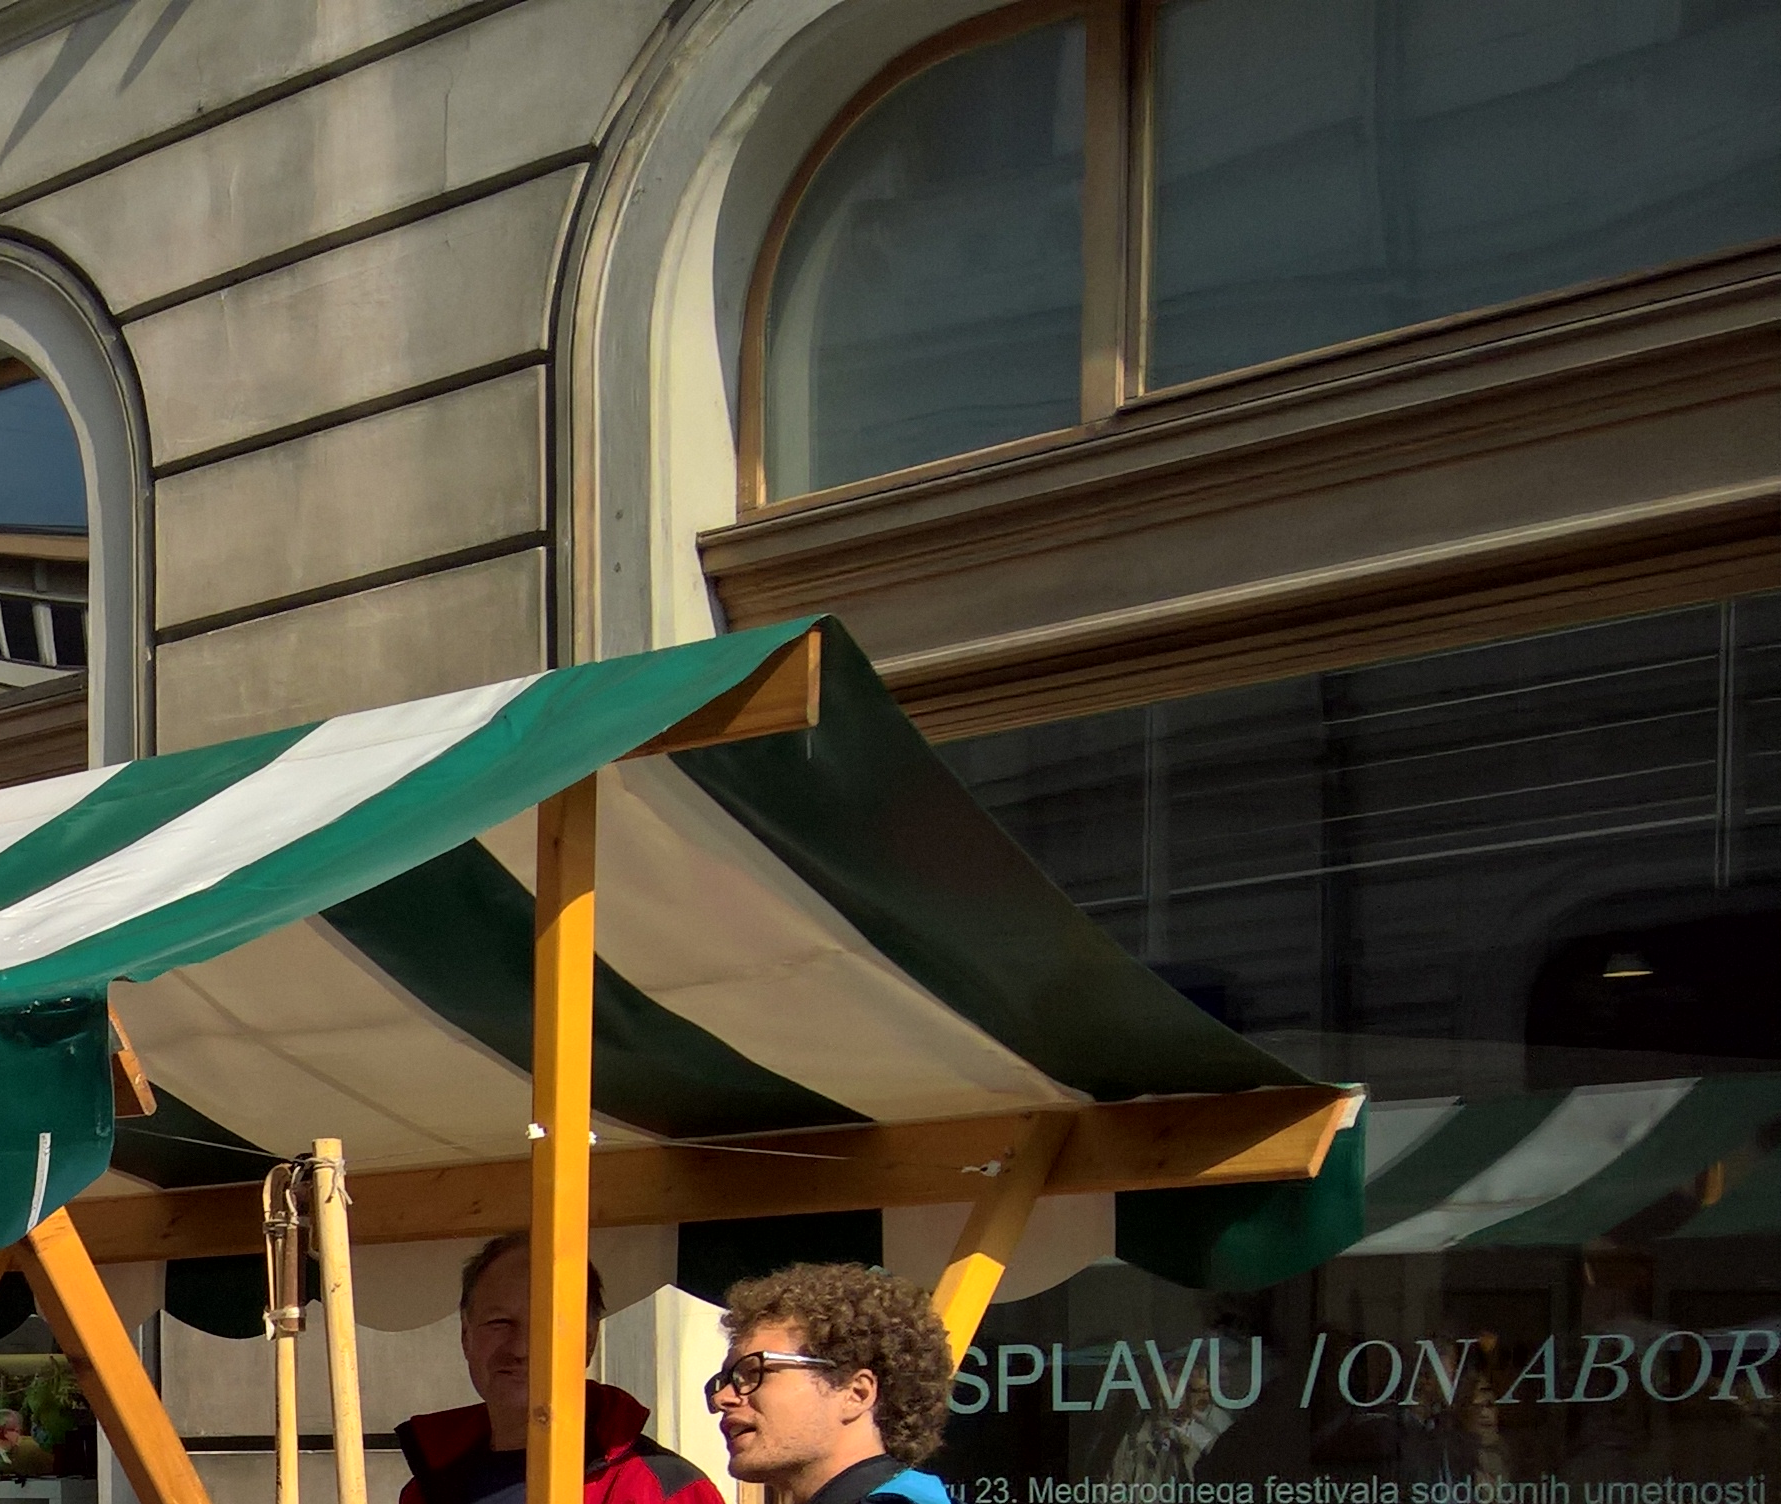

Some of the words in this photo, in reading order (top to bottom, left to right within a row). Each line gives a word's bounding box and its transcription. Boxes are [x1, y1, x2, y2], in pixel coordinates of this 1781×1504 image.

[947, 1336, 1262, 1414] SPLAVU
[1495, 1330, 1781, 1403] ABOR
[975, 1477, 1018, 1504] 23.
[1265, 1475, 1399, 1504] festivala
